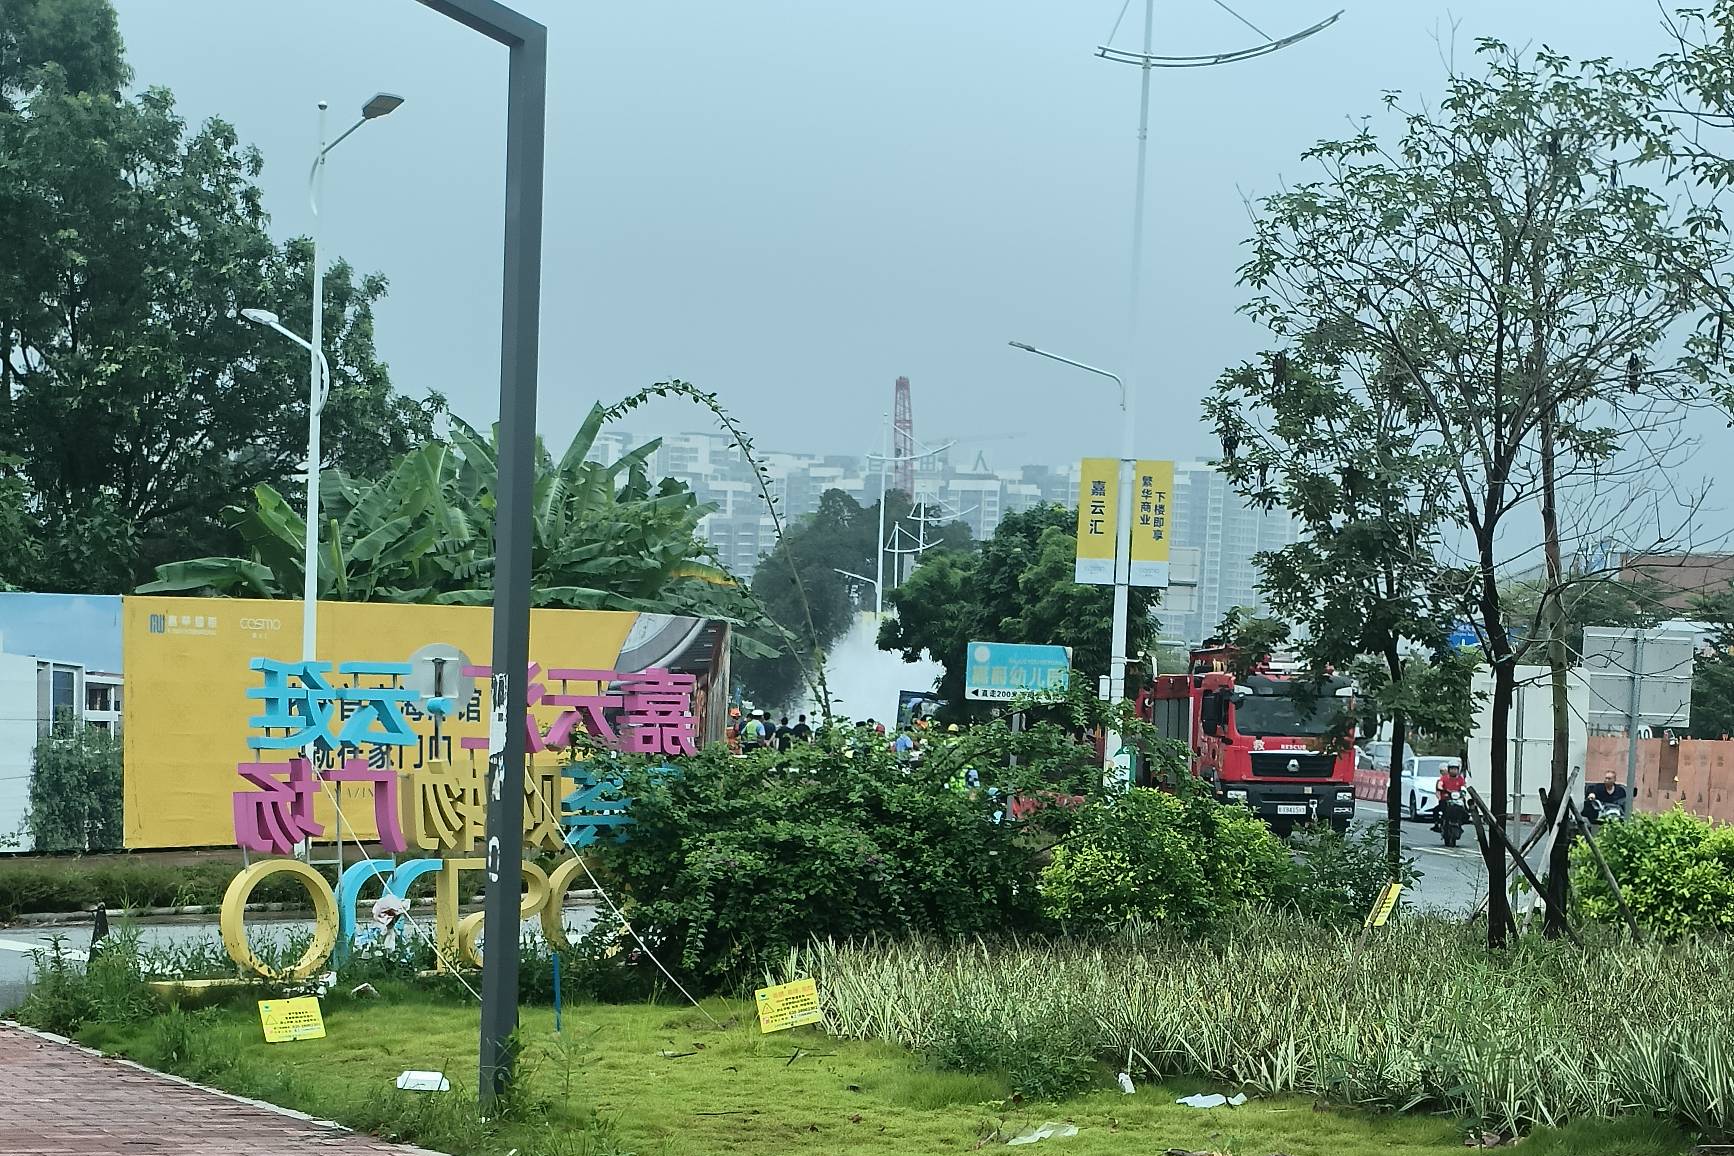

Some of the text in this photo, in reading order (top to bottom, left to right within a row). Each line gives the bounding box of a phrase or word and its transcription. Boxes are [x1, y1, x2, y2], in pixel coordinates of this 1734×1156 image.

[1089, 480, 1106, 535] 嘉云汇
[1140, 475, 1153, 526] 繁华商业
[1152, 491, 1166, 541] 下楼即享
